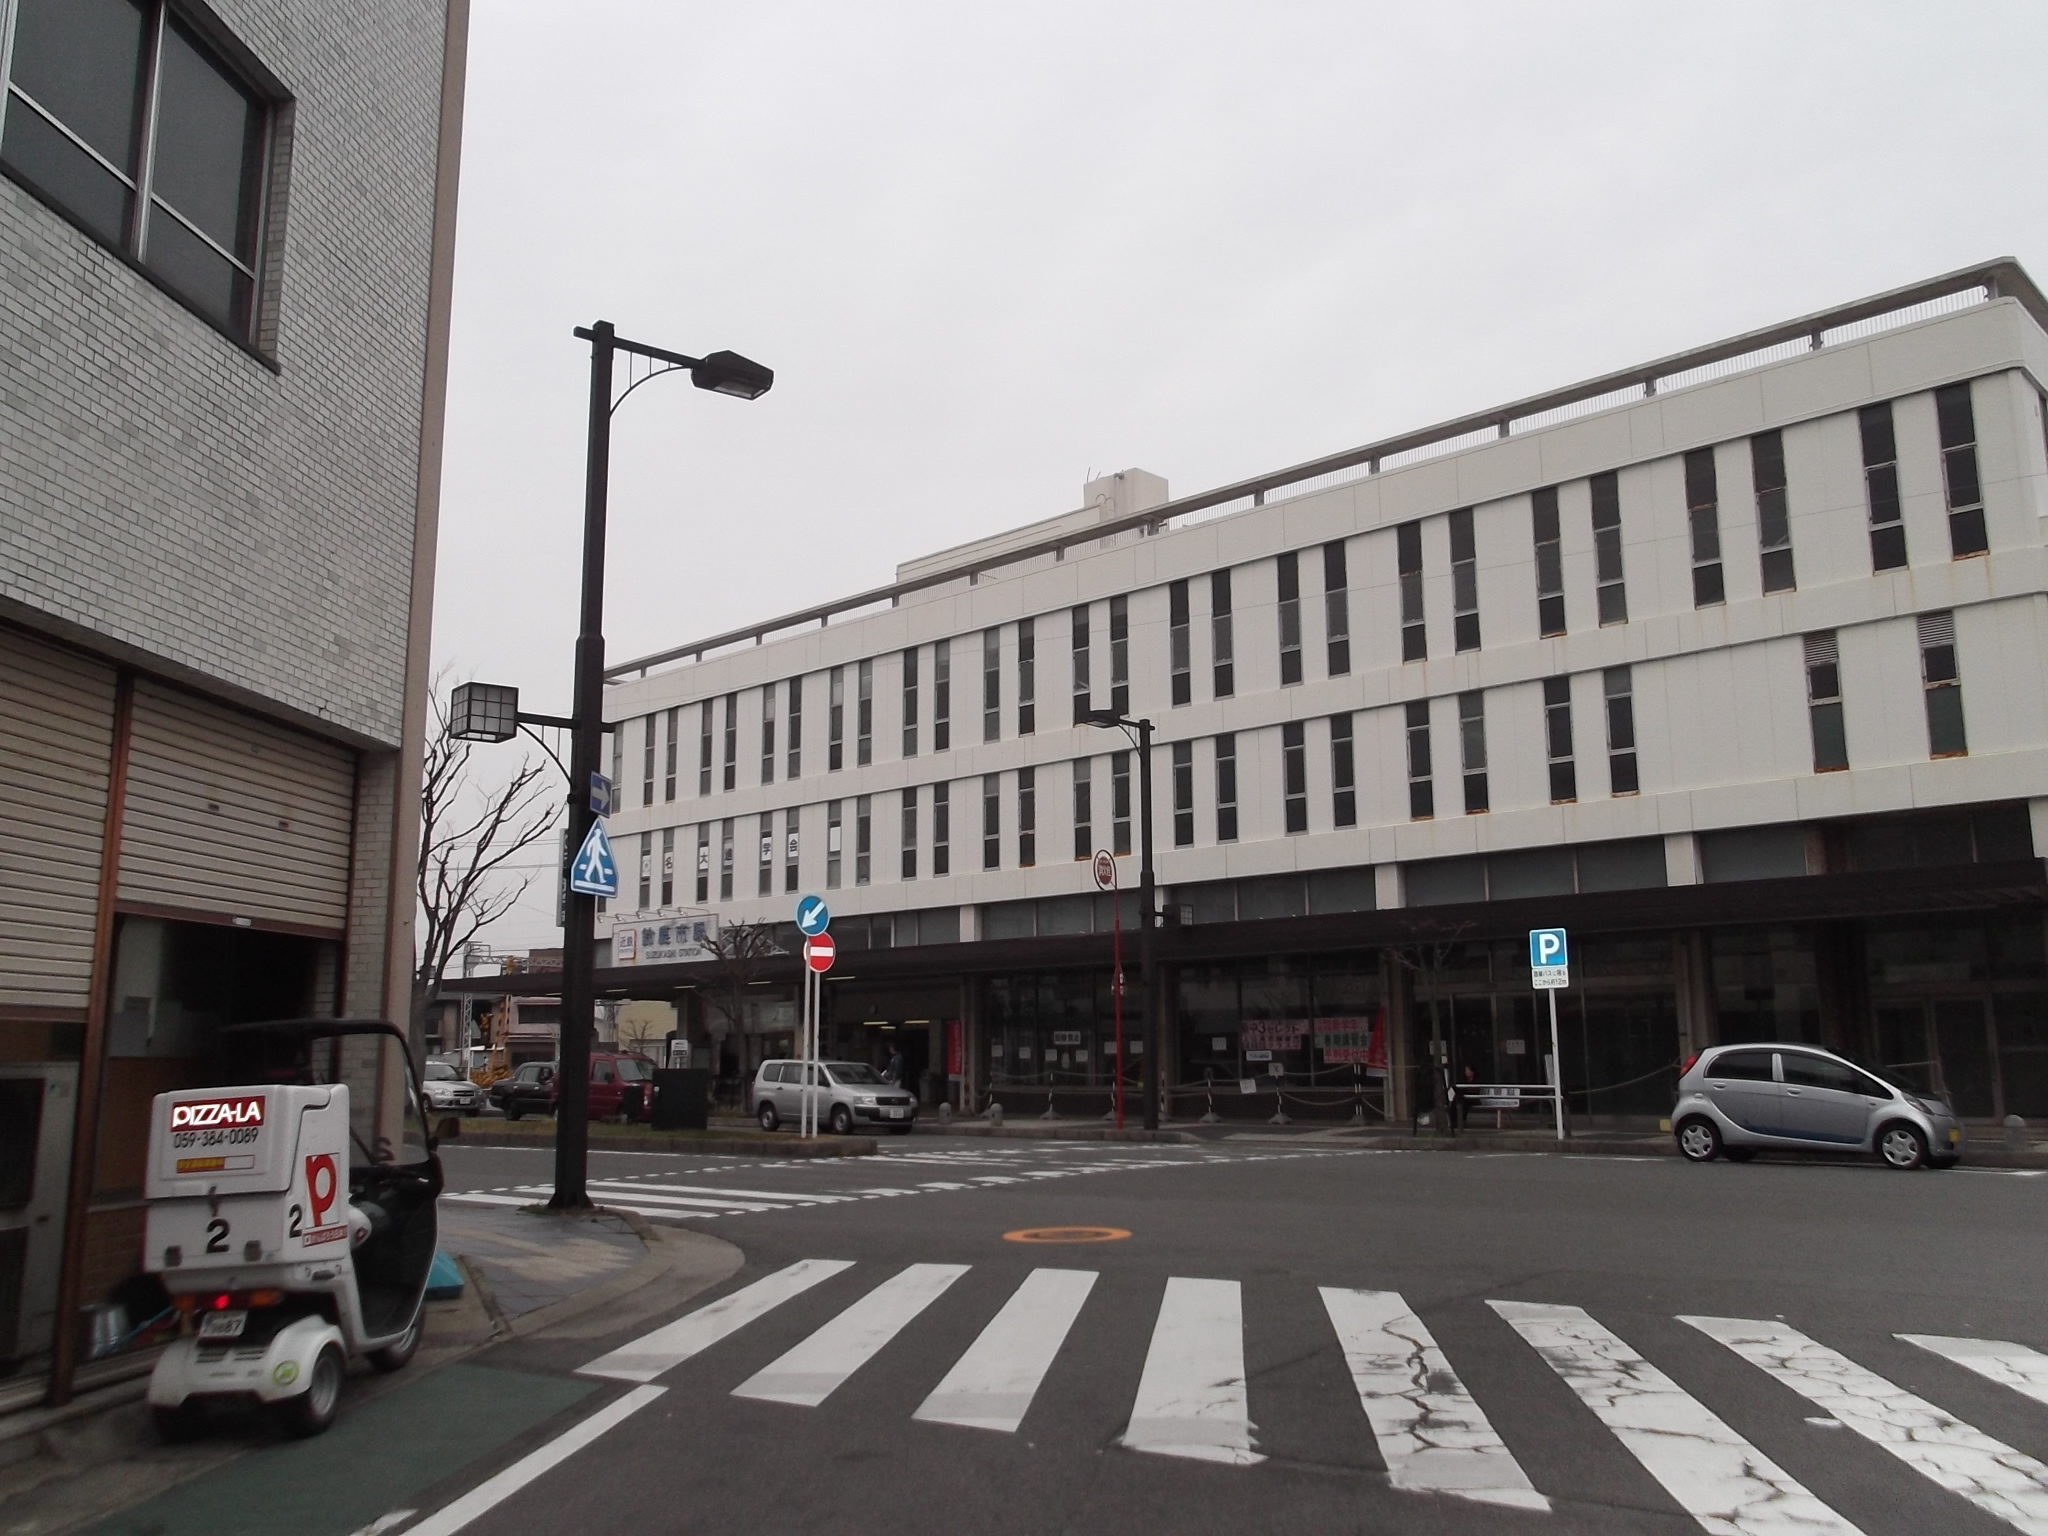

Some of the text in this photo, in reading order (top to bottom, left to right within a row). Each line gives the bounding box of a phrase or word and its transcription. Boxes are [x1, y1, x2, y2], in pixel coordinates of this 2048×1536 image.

[1539, 933, 1560, 965] P
[172, 1101, 261, 1127] PIZZA-LA
[174, 1127, 259, 1148] 059-384-0089
[205, 1218, 231, 1254] 2
[289, 1203, 303, 1239] 2
